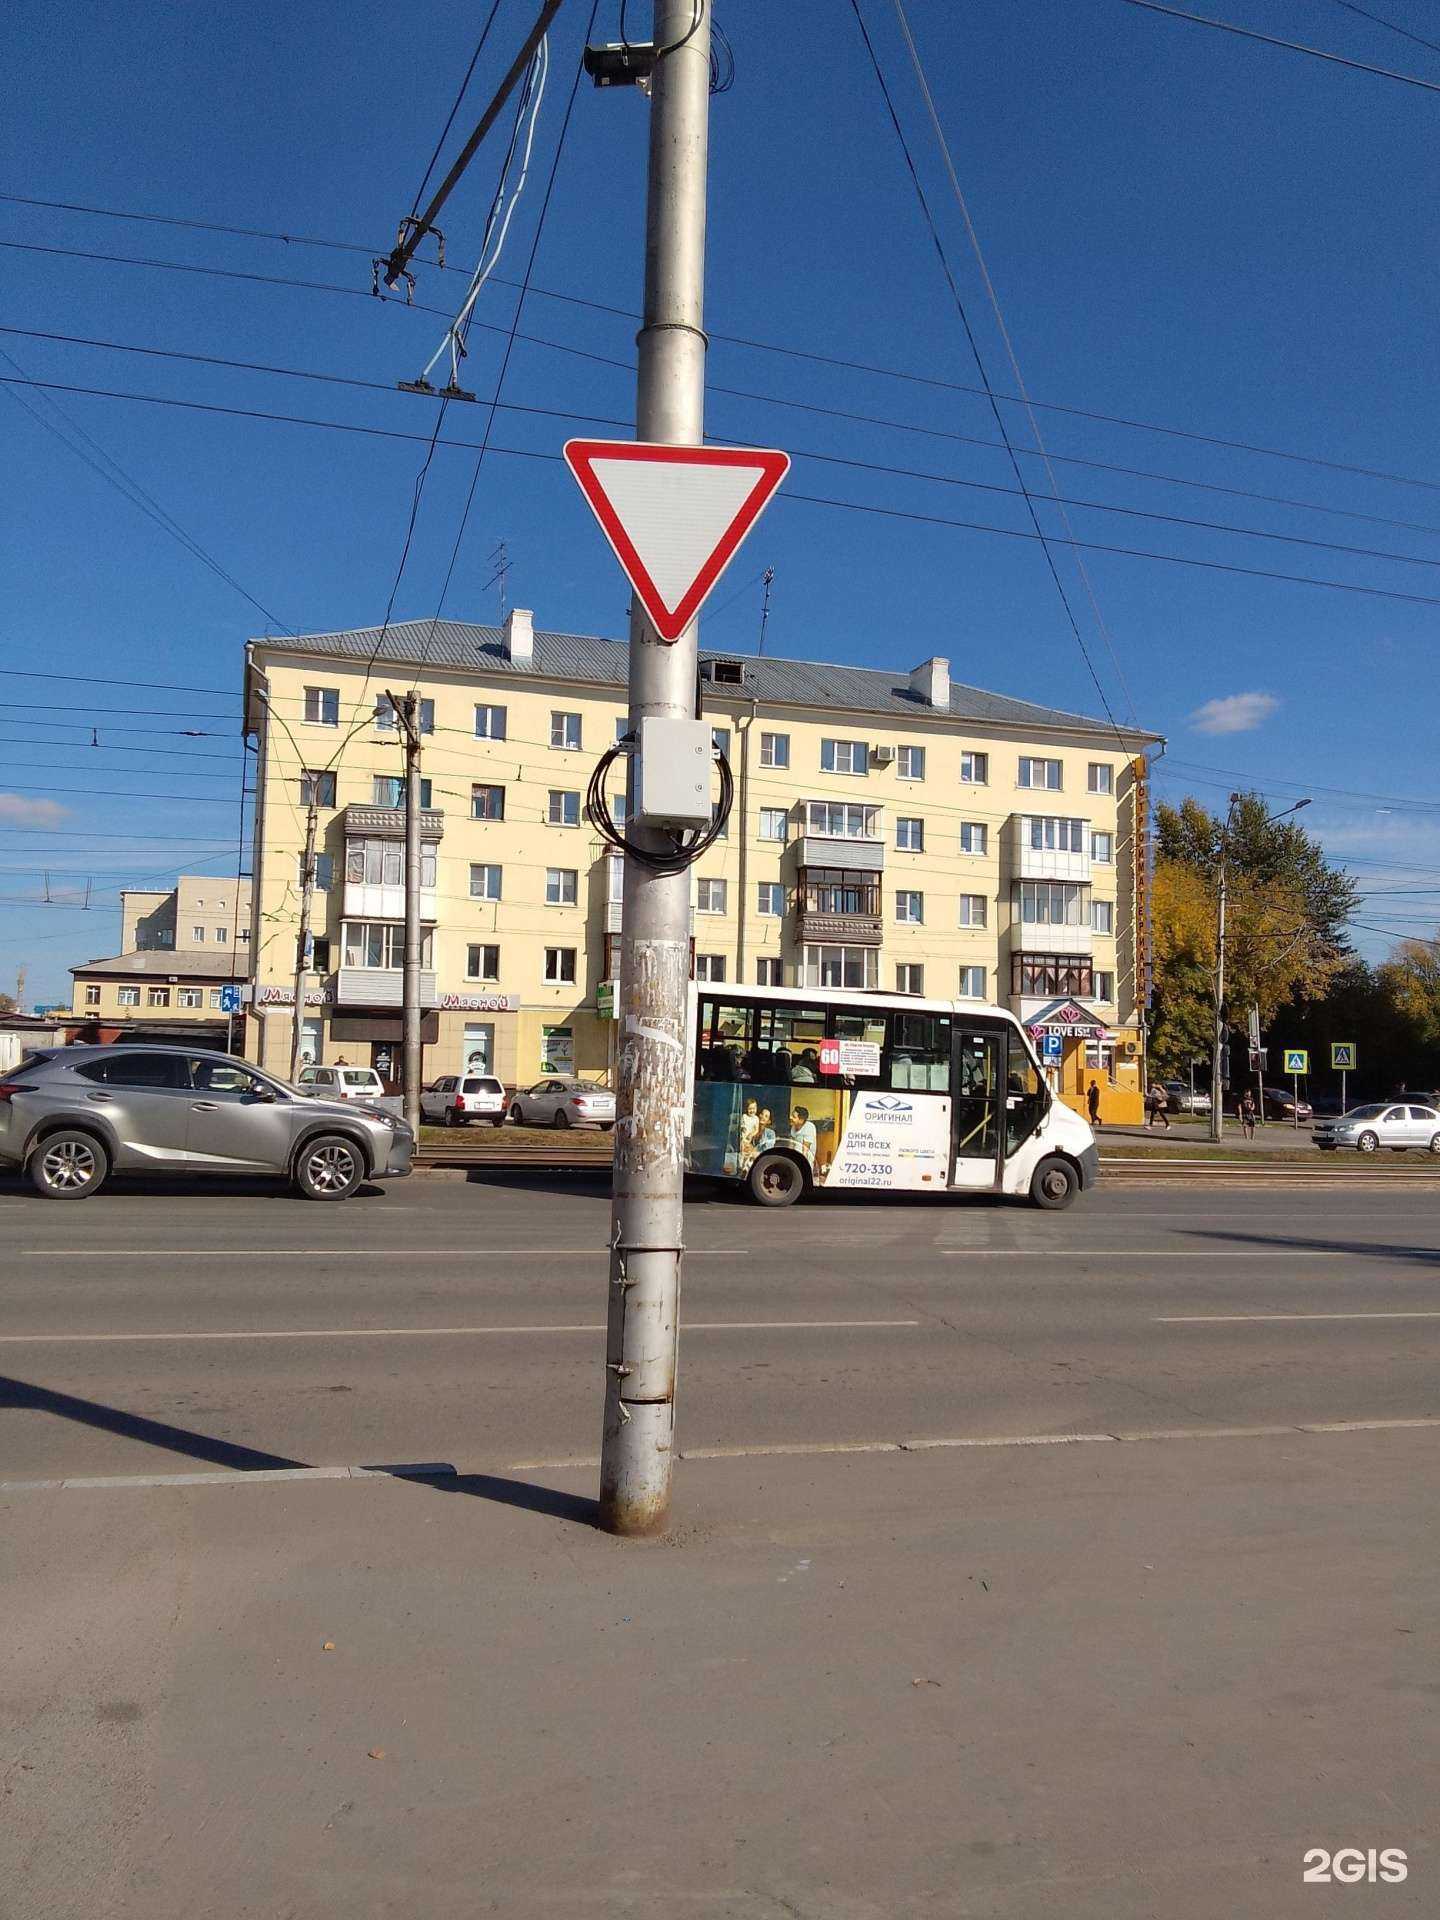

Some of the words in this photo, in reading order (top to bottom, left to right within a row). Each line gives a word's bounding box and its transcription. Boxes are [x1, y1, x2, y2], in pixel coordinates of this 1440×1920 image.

[443, 992, 509, 1010] Мясной
[1048, 1026, 1073, 1037] LOVE
[820, 1048, 840, 1066] 60
[864, 1112, 913, 1122] ОРИГИНАЛ
[847, 1131, 874, 1141] ОКНА
[846, 1140, 867, 1151] ДЛЯ
[868, 1141, 891, 1150] ВСЕХ
[844, 1162, 893, 1175] 720-330
[839, 1177, 892, 1187] original22.ru
